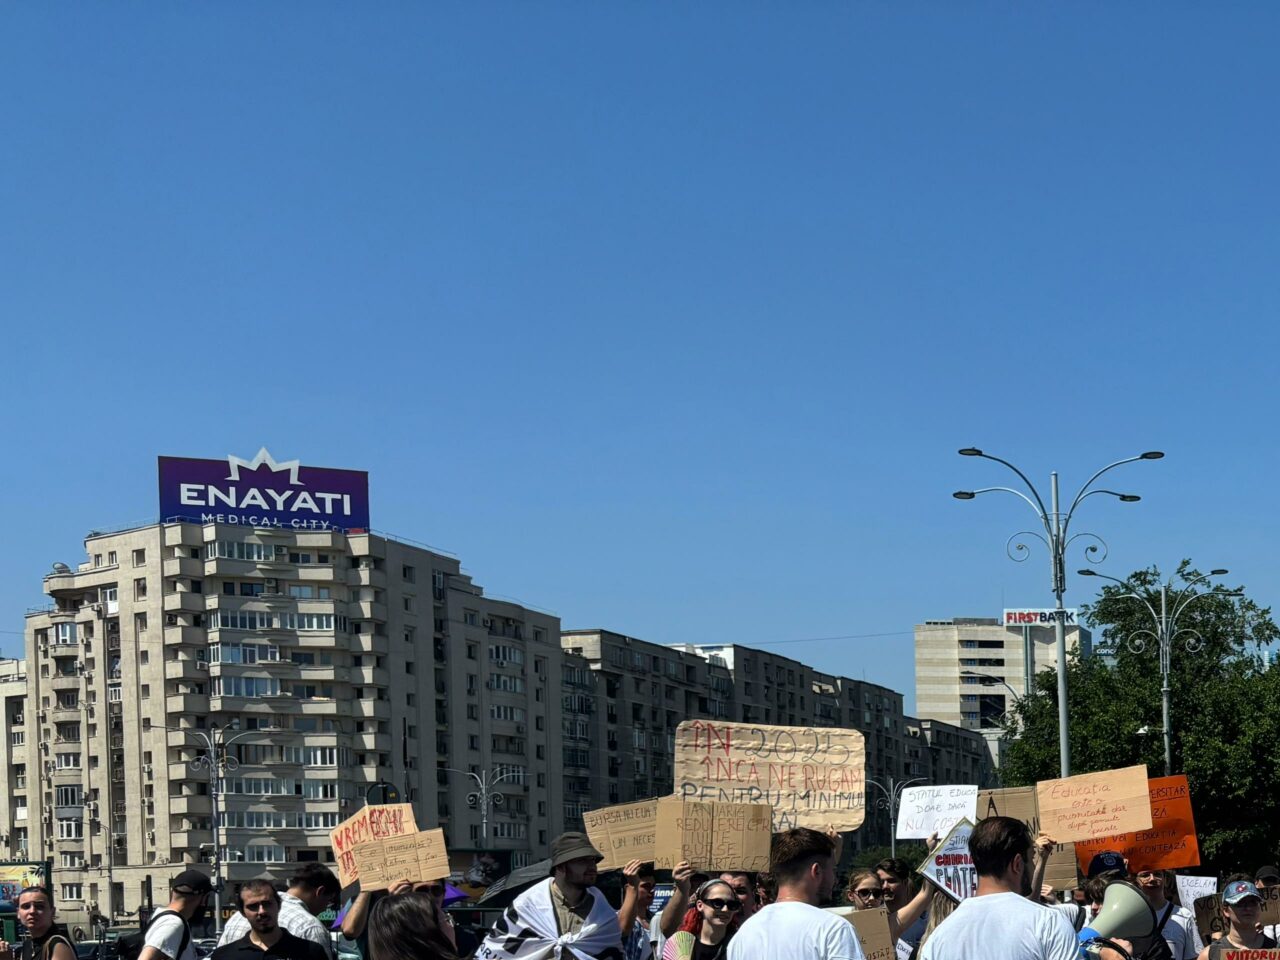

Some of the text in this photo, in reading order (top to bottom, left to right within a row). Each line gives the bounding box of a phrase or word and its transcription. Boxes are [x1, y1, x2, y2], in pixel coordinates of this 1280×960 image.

[180, 483, 351, 516] ENAYATI
[201, 513, 330, 530] MEDICAL CITY
[1005, 611, 1075, 624] FIRSTBAK
[691, 719, 850, 765] ÎN 2025
[768, 763, 800, 789] NE
[680, 782, 781, 807] PENTRU
[1150, 784, 1186, 800] ERSITAR
[334, 815, 369, 851] VREM
[632, 833, 656, 846] NECES
